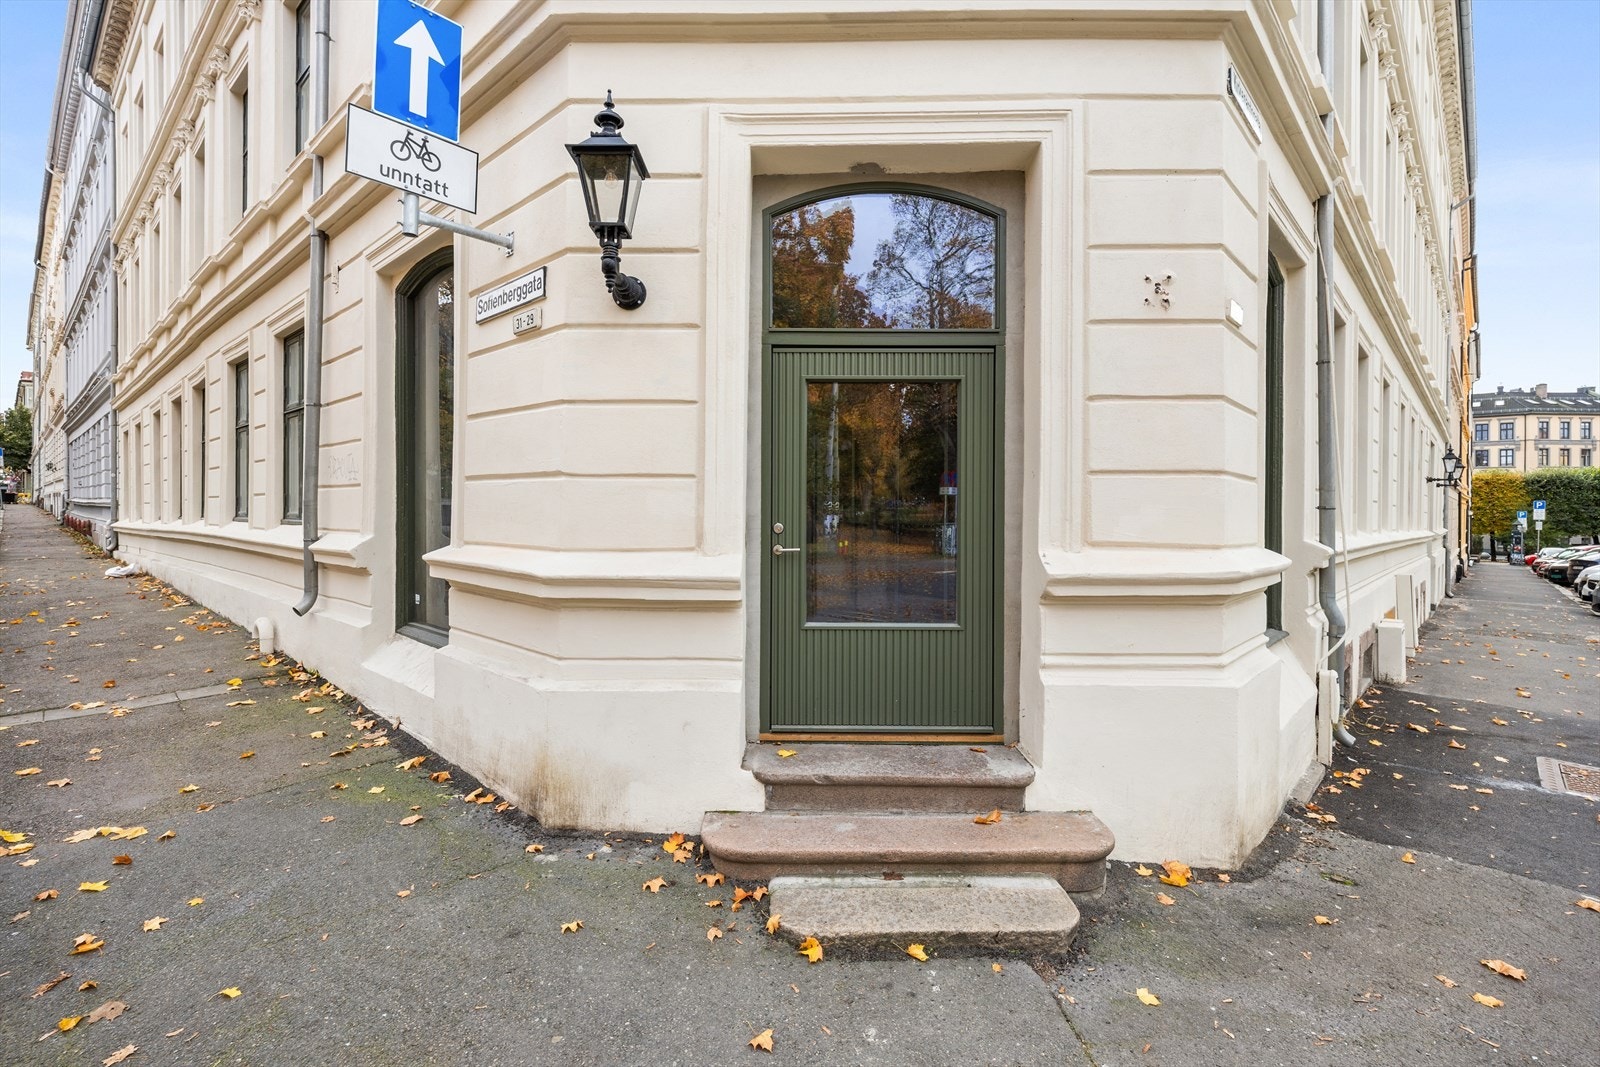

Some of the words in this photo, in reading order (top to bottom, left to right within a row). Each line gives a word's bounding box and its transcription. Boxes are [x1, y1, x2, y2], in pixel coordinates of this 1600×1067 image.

[380, 164, 449, 198] unntatt
[477, 275, 542, 315] Sofienberggata
[1536, 501, 1543, 509] P
